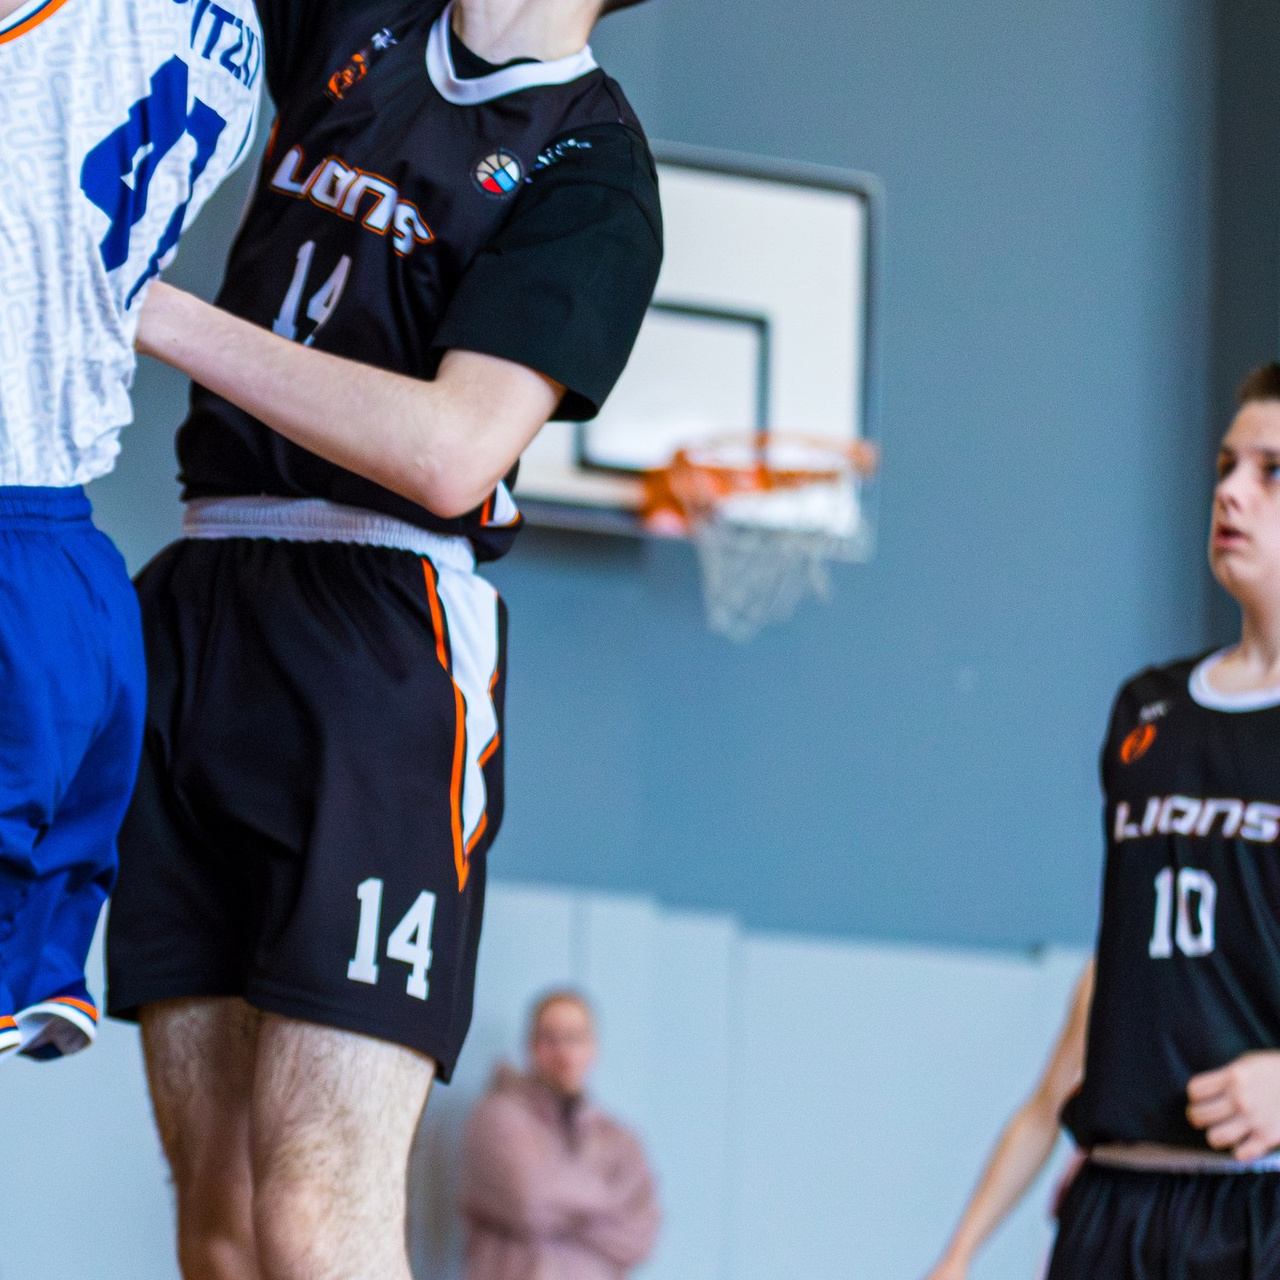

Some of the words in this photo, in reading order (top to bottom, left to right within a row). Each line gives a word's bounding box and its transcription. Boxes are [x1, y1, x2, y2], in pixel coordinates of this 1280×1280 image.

[271, 238, 353, 348] 14
[346, 876, 438, 1002] 14
[1147, 866, 1218, 959] 10
